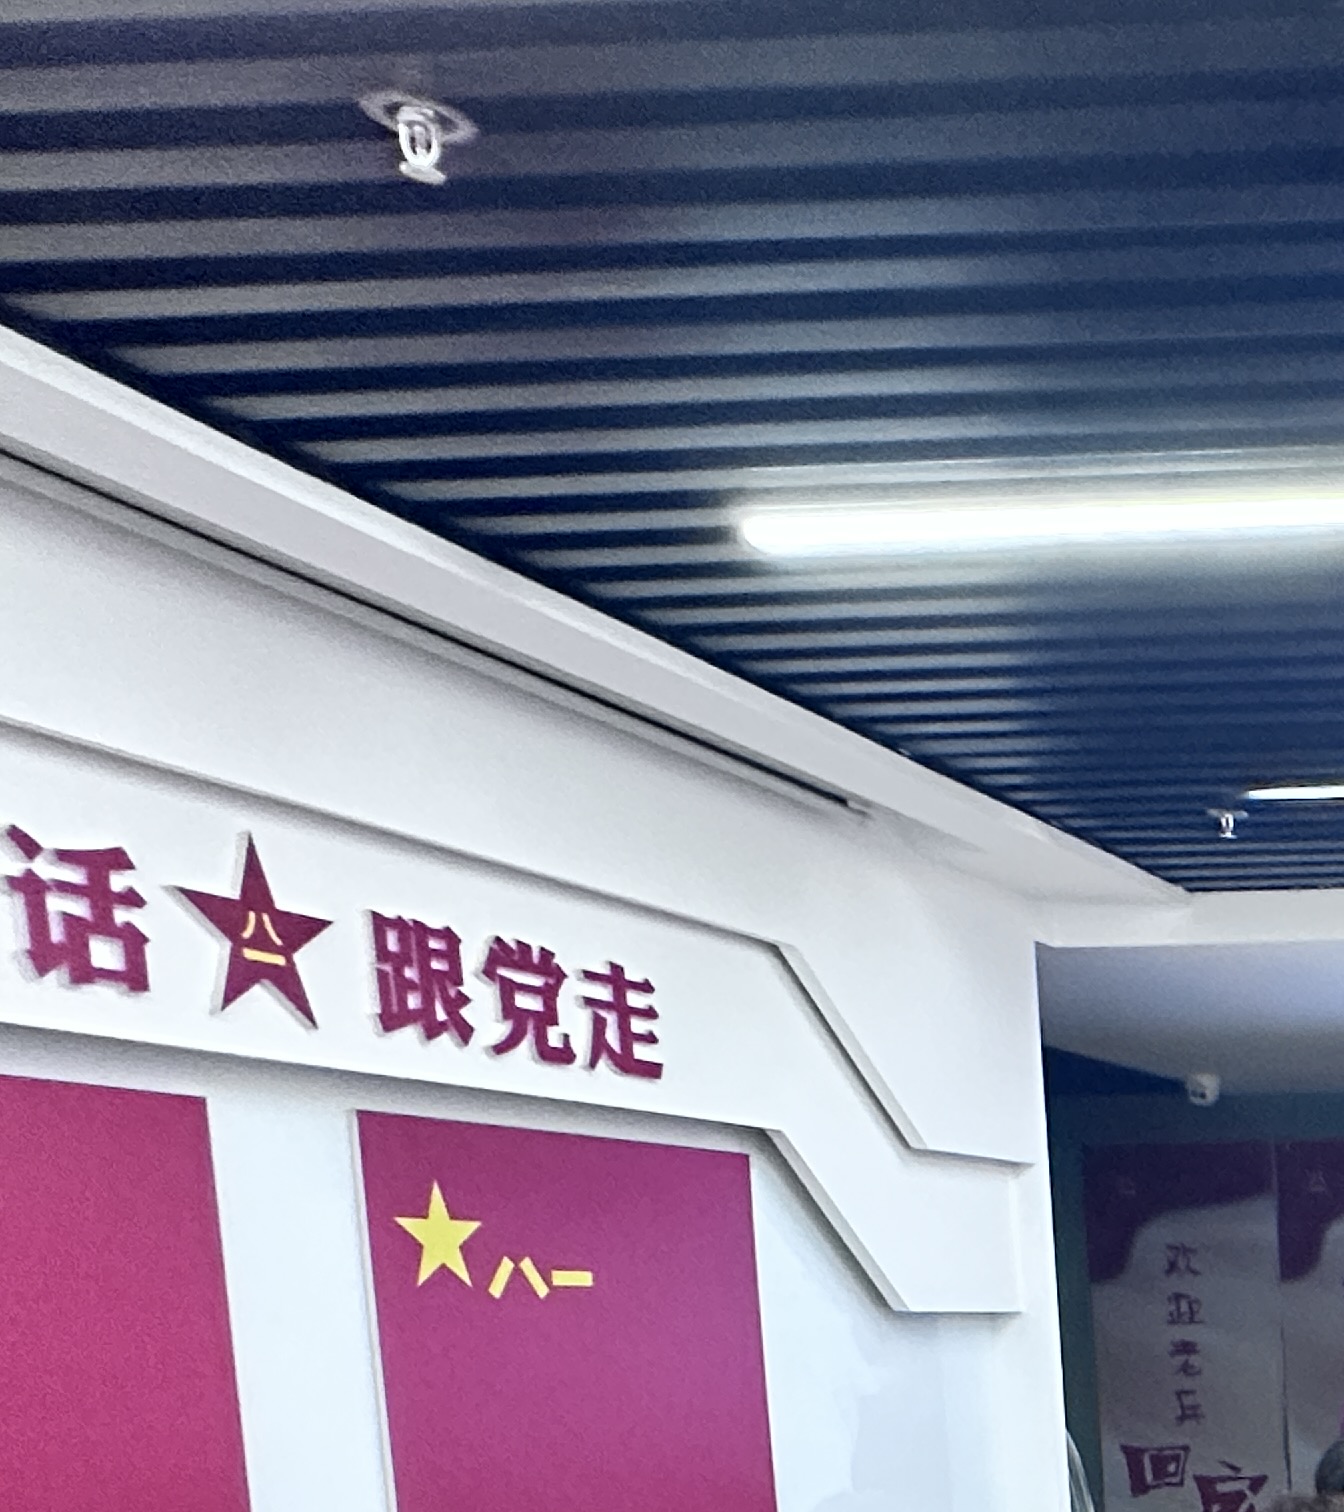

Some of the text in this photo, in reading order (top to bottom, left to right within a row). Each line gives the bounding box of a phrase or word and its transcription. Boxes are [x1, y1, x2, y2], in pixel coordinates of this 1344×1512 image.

[3, 824, 664, 1079] 话 跟党走
